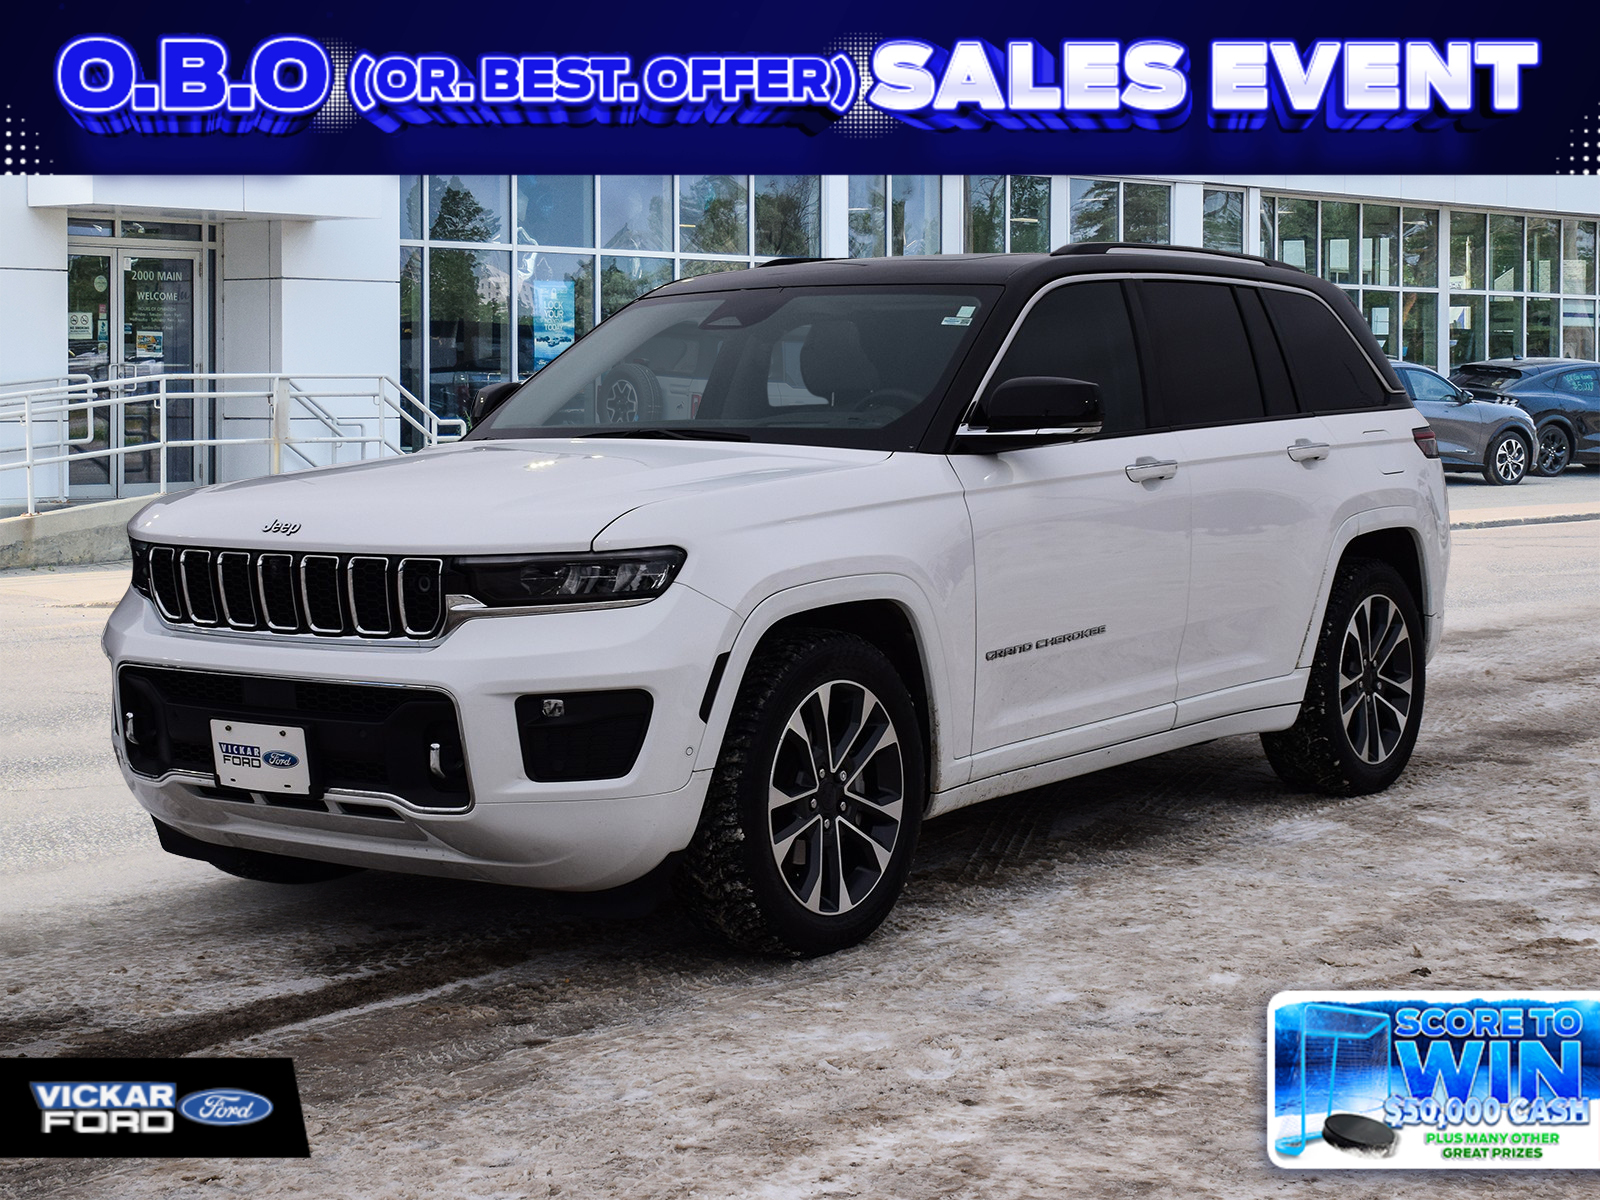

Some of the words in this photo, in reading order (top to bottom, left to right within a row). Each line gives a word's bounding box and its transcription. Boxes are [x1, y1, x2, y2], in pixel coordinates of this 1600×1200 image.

[131, 270, 155, 281] 2000
[157, 271, 183, 281] MAIN
[136, 291, 178, 301] WELCOME
[544, 310, 564, 318] YOUR
[262, 519, 302, 537] Jeep
[985, 641, 1033, 662] GRAND
[1035, 624, 1107, 650] CHEROKEE
[220, 743, 260, 757] VICKAR
[223, 755, 261, 768] FORD
[269, 752, 291, 766] Ford
